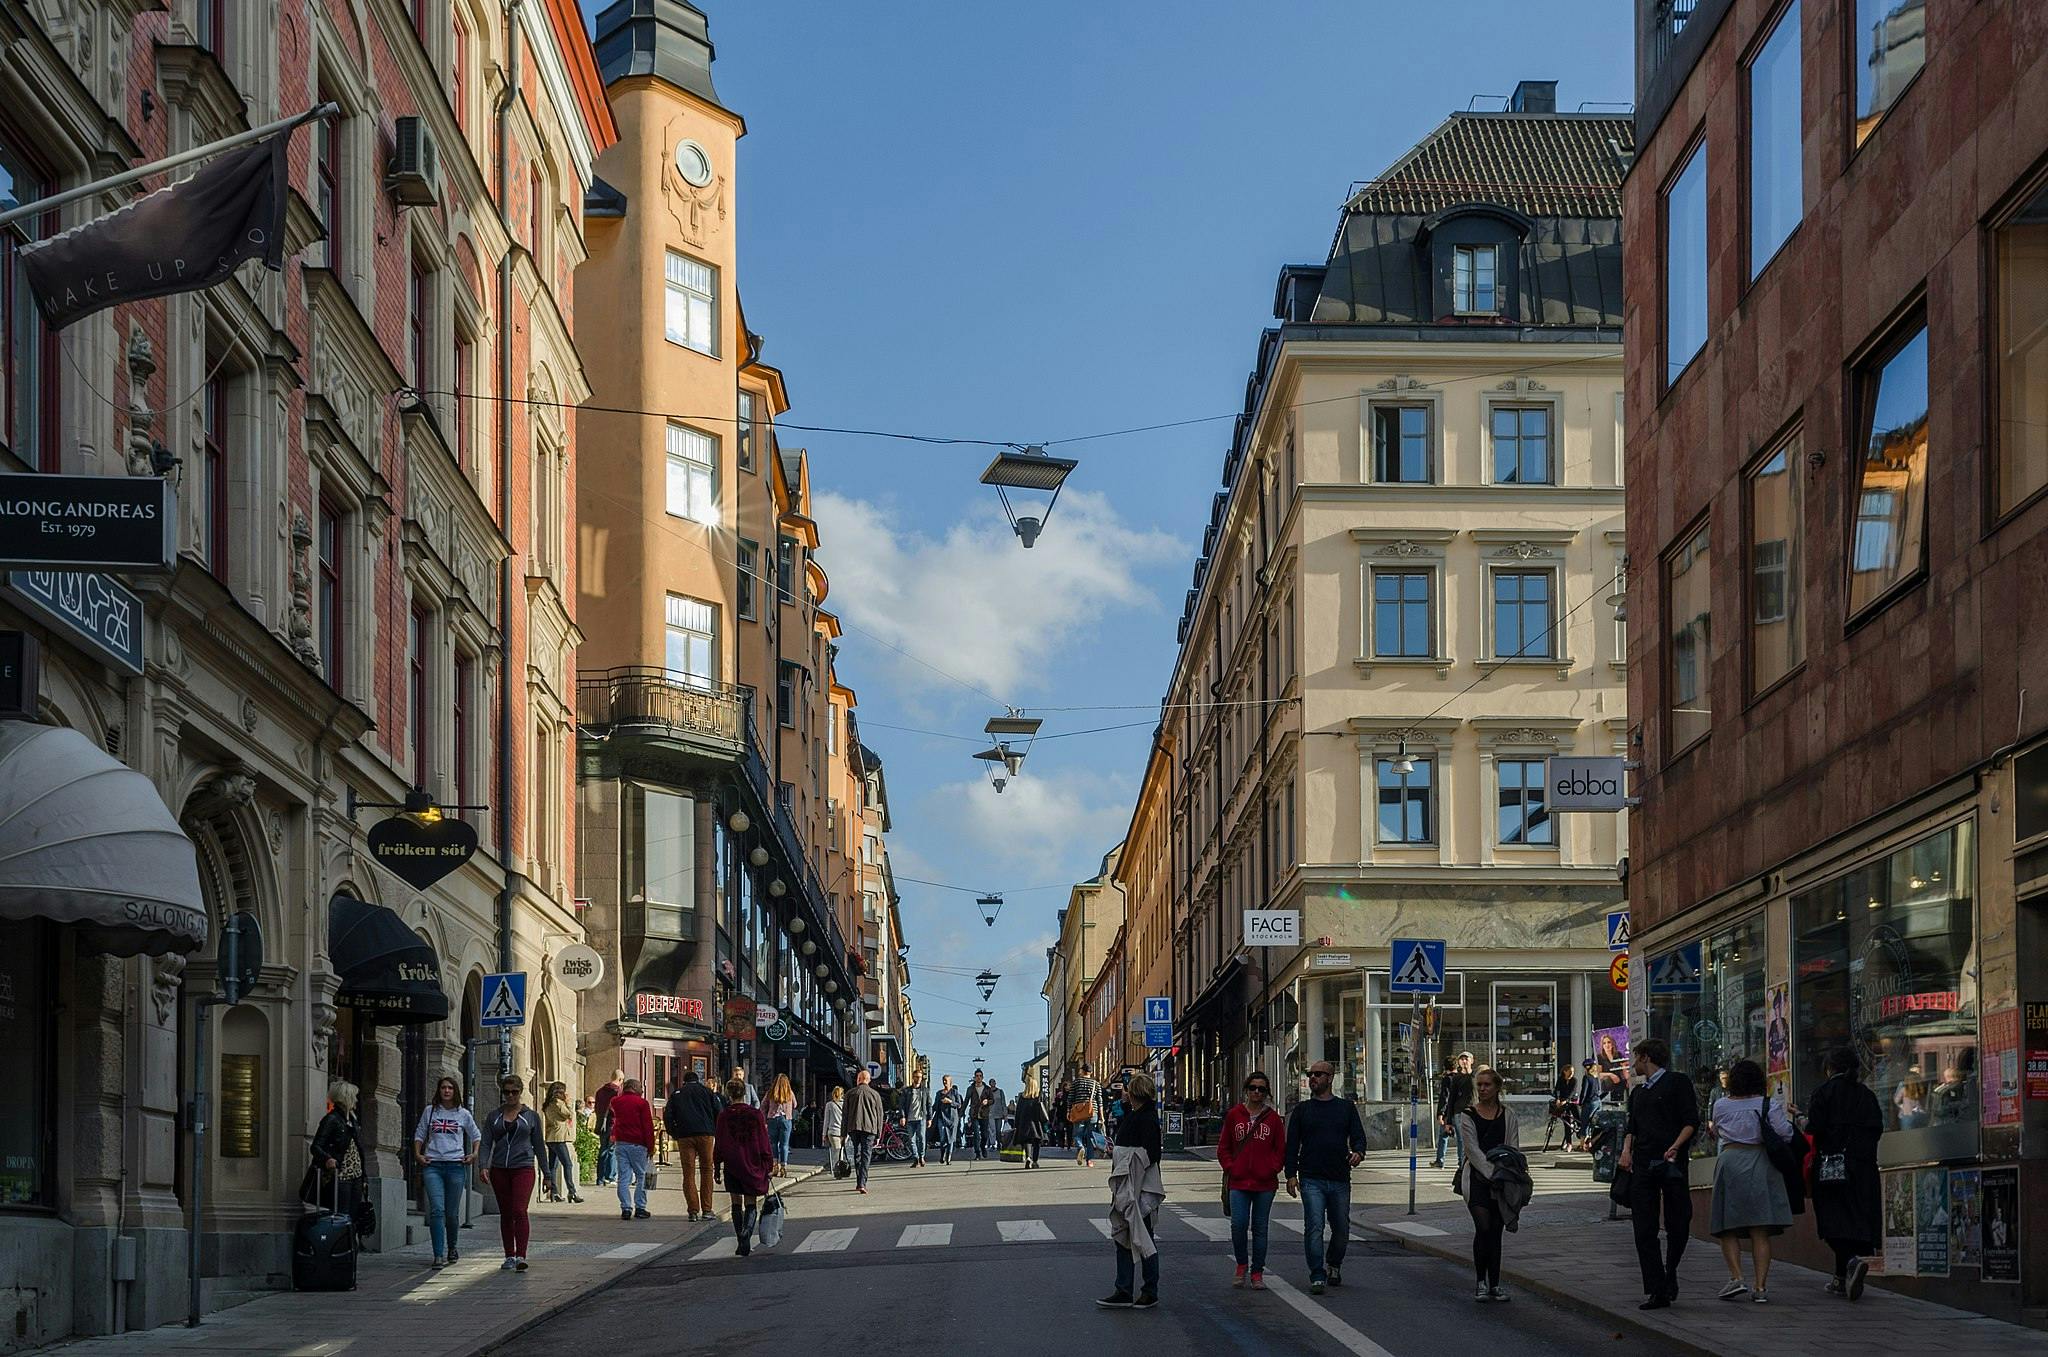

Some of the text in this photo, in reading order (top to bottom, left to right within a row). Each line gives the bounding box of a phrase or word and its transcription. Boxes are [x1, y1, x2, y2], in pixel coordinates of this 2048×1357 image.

[44, 271, 121, 316] MAKE
[147, 260, 186, 282] UP
[64, 502, 156, 519] ANDREAS
[67, 523, 96, 537] 1979
[1557, 769, 1617, 795] ebba
[378, 842, 466, 856] fröken söt
[125, 902, 194, 931] SALONG
[1251, 917, 1292, 932] FACE
[563, 966, 595, 978] tango
[378, 995, 411, 1009] söt!
[636, 993, 703, 1021] BEEFEATER
[6, 1155, 28, 1169] DROP
